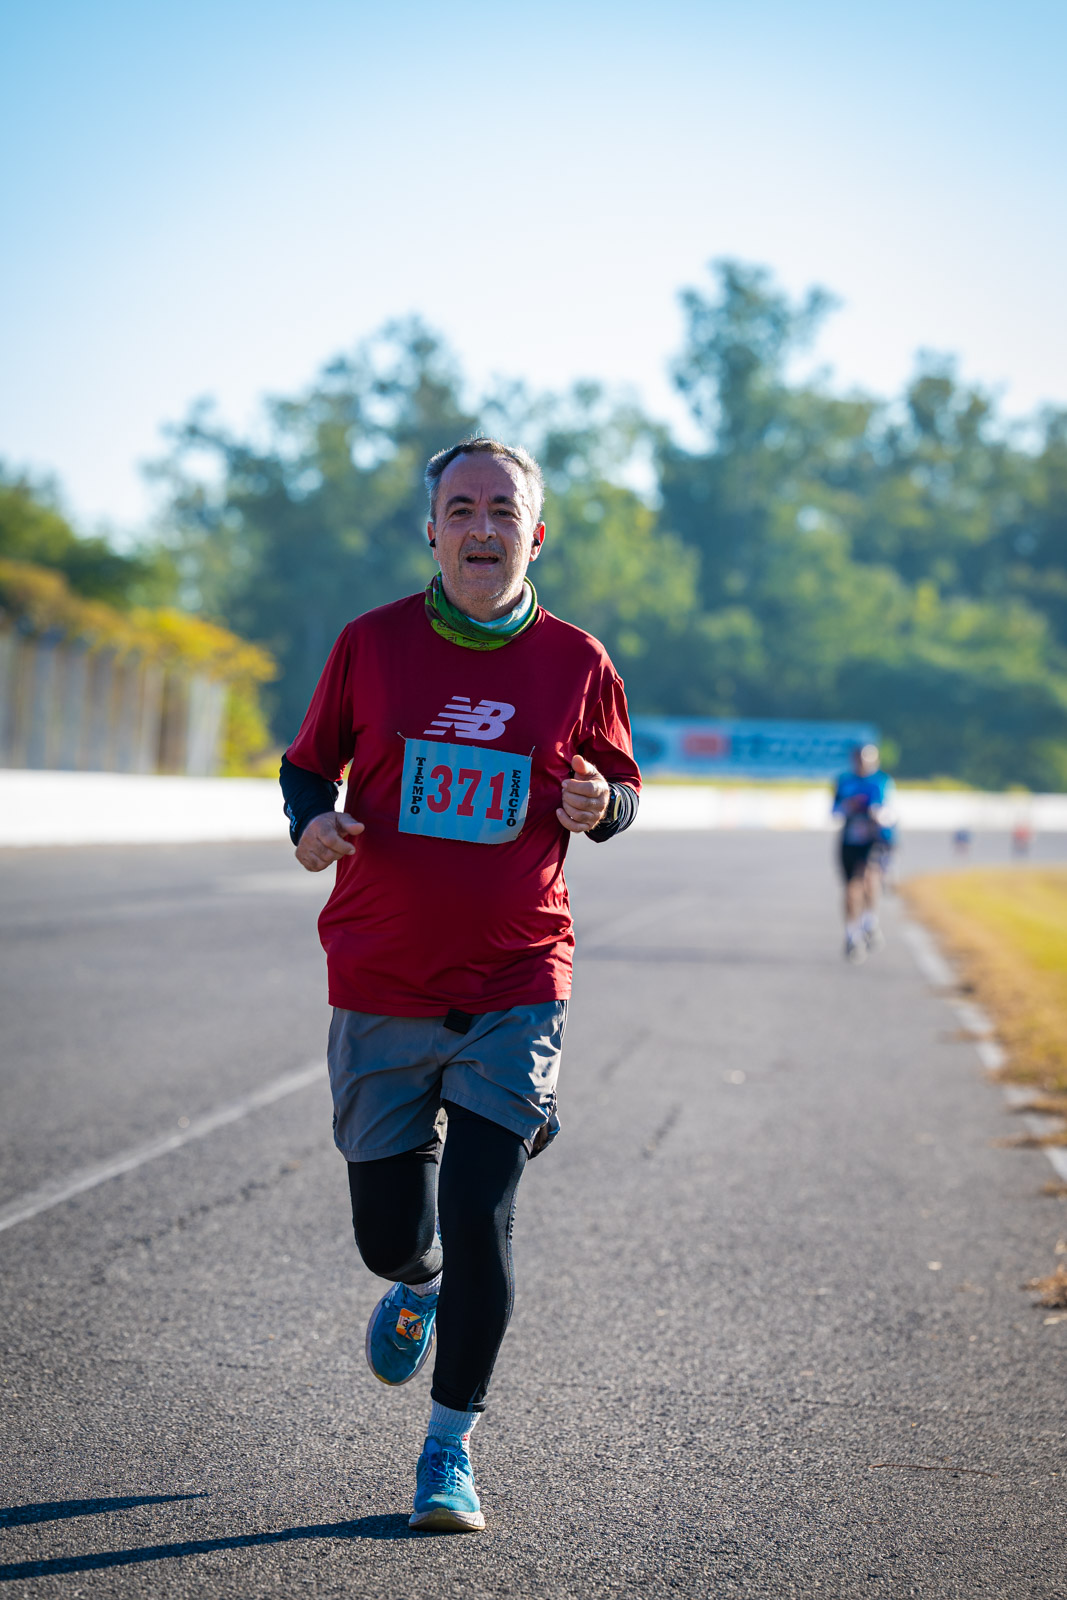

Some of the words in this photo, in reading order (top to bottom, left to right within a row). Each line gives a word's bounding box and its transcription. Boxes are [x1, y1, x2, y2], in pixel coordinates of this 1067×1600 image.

[423, 696, 516, 740] NB
[410, 757, 426, 815] TIEMPO
[427, 765, 505, 820] 371
[506, 769, 521, 827] EXACTO
